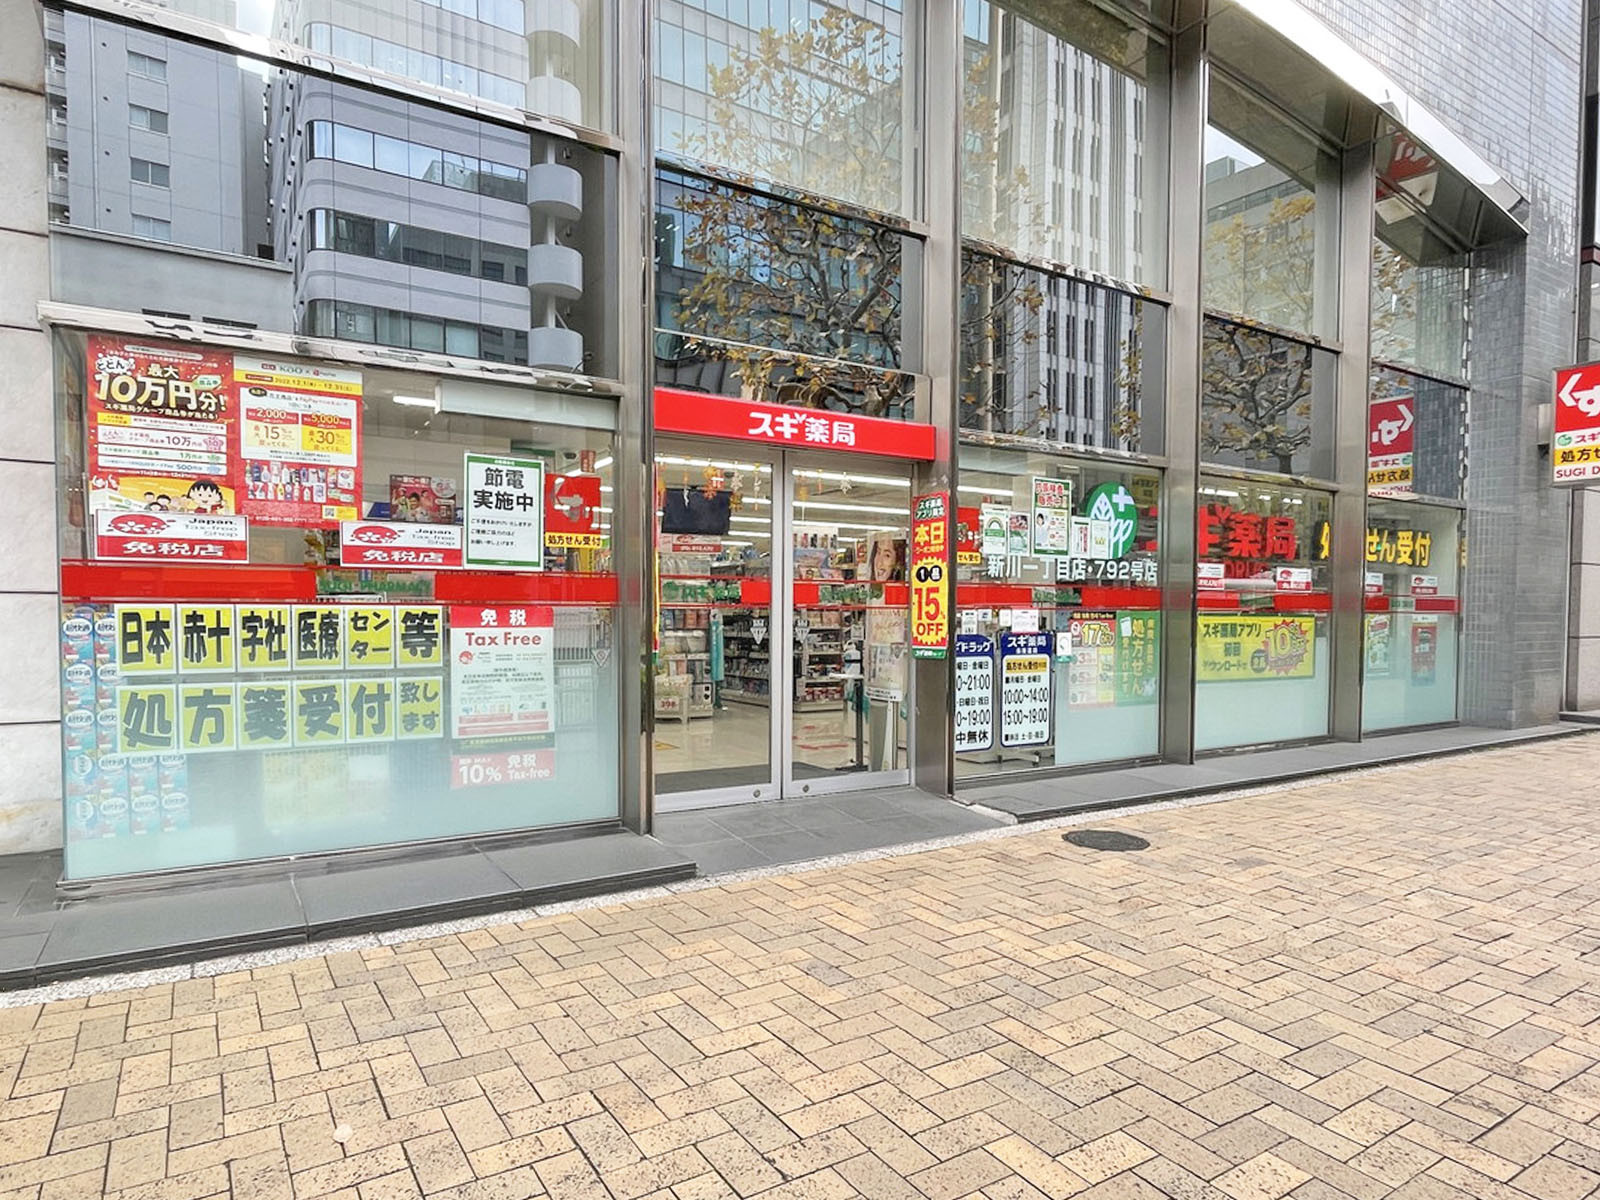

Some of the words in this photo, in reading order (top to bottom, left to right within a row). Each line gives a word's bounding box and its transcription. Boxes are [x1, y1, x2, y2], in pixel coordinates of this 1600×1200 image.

[148, 363, 179, 379] 最大
[748, 412, 856, 446] スギ薬局
[484, 468, 524, 489] 節電
[1556, 467, 1586, 478] SUGI
[473, 489, 534, 512] 実施中
[548, 535, 601, 547] 処方せん受付
[914, 522, 945, 546] 本日
[122, 541, 224, 557] 免税店
[1366, 527, 1431, 567] せん受付
[362, 549, 444, 563] 免税店
[480, 609, 526, 626] 免税
[916, 623, 943, 636] OFF
[465, 632, 498, 647] Tax
[503, 631, 542, 646] Free
[1007, 635, 1047, 648] スギ薬局
[1132, 618, 1146, 697] 処方せん
[507, 752, 537, 768] 免税
[459, 763, 502, 784] 10%
